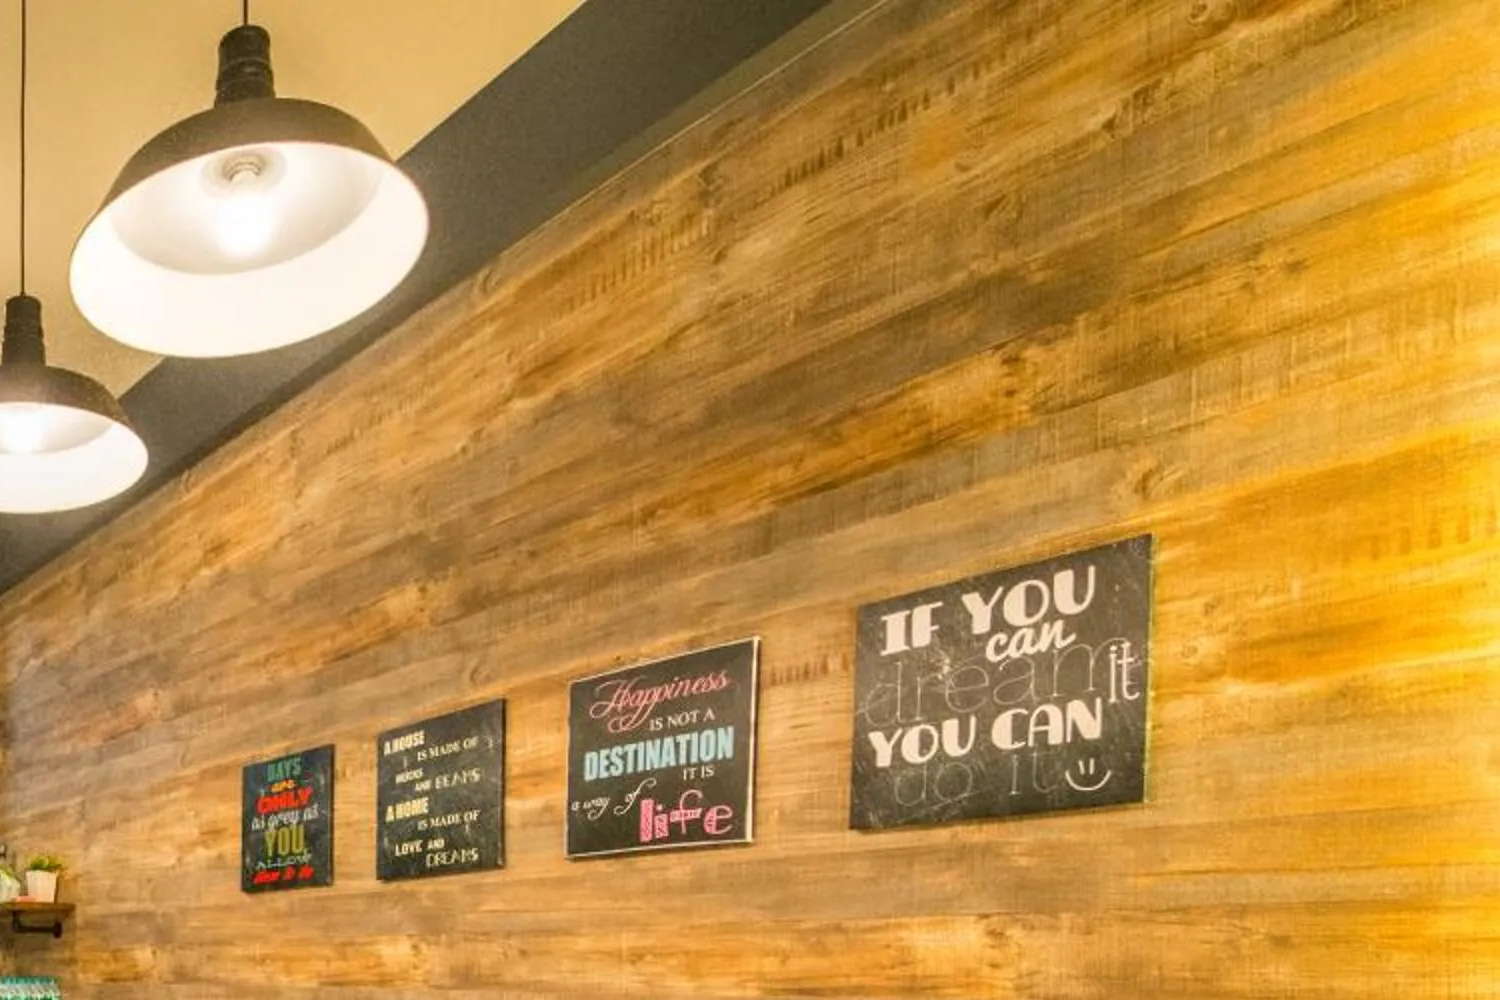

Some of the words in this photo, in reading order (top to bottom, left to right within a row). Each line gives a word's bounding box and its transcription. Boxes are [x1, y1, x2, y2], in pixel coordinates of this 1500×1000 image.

[880, 601, 943, 656] IF
[962, 565, 1095, 635] YOU
[985, 619, 1076, 663] can
[1109, 641, 1141, 703] it
[589, 670, 736, 733] Happiness
[650, 716, 663, 731] IS
[667, 711, 697, 729] NOT
[703, 708, 716, 721] A
[392, 730, 425, 752] HOUSE
[868, 715, 976, 768] YOU
[991, 697, 1102, 750] CAN
[417, 750, 426, 761] IS
[583, 725, 735, 782] DESTINATION
[682, 767, 697, 780] IT
[701, 764, 715, 778] IS
[385, 804, 395, 823] A
[417, 820, 428, 830] IS
[429, 812, 461, 828] MADE
[464, 809, 481, 822] OF
[640, 789, 733, 843] life
[264, 822, 306, 858] YOU
[395, 839, 423, 857] LOVE
